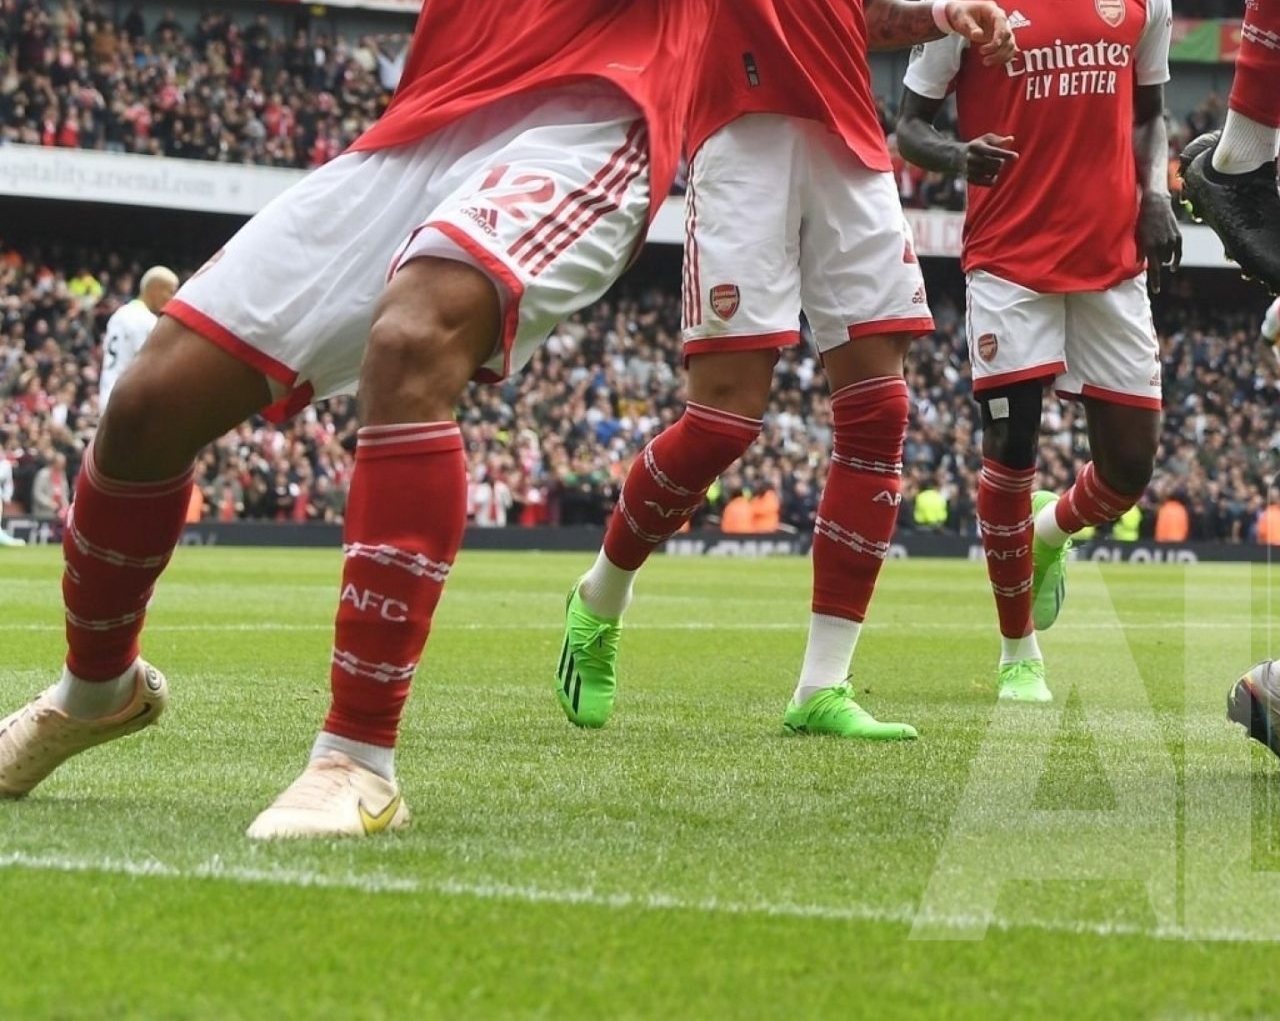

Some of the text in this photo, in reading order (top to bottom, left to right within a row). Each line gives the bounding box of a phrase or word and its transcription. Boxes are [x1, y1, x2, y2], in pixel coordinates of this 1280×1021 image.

[1004, 39, 1131, 77] Emirates
[1026, 70, 1116, 101] FLY BETTER
[478, 165, 556, 220] 12
[341, 583, 409, 623] AFC
